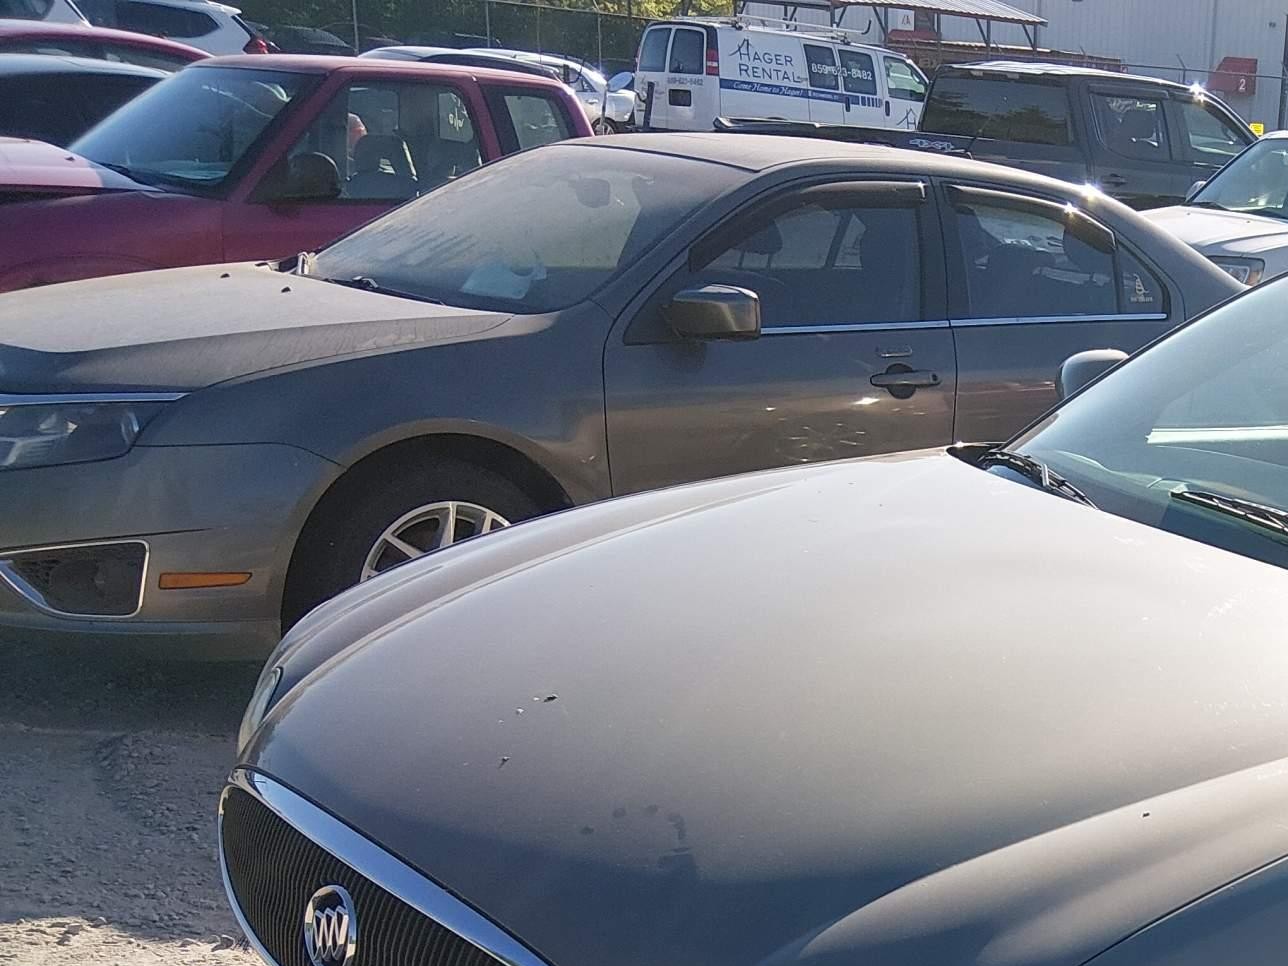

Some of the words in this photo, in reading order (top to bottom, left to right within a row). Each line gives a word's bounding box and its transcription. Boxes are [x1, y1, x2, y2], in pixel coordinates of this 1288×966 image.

[729, 38, 794, 66] HAGER
[738, 63, 801, 83] RENTAL
[1239, 78, 1246, 91] 2
